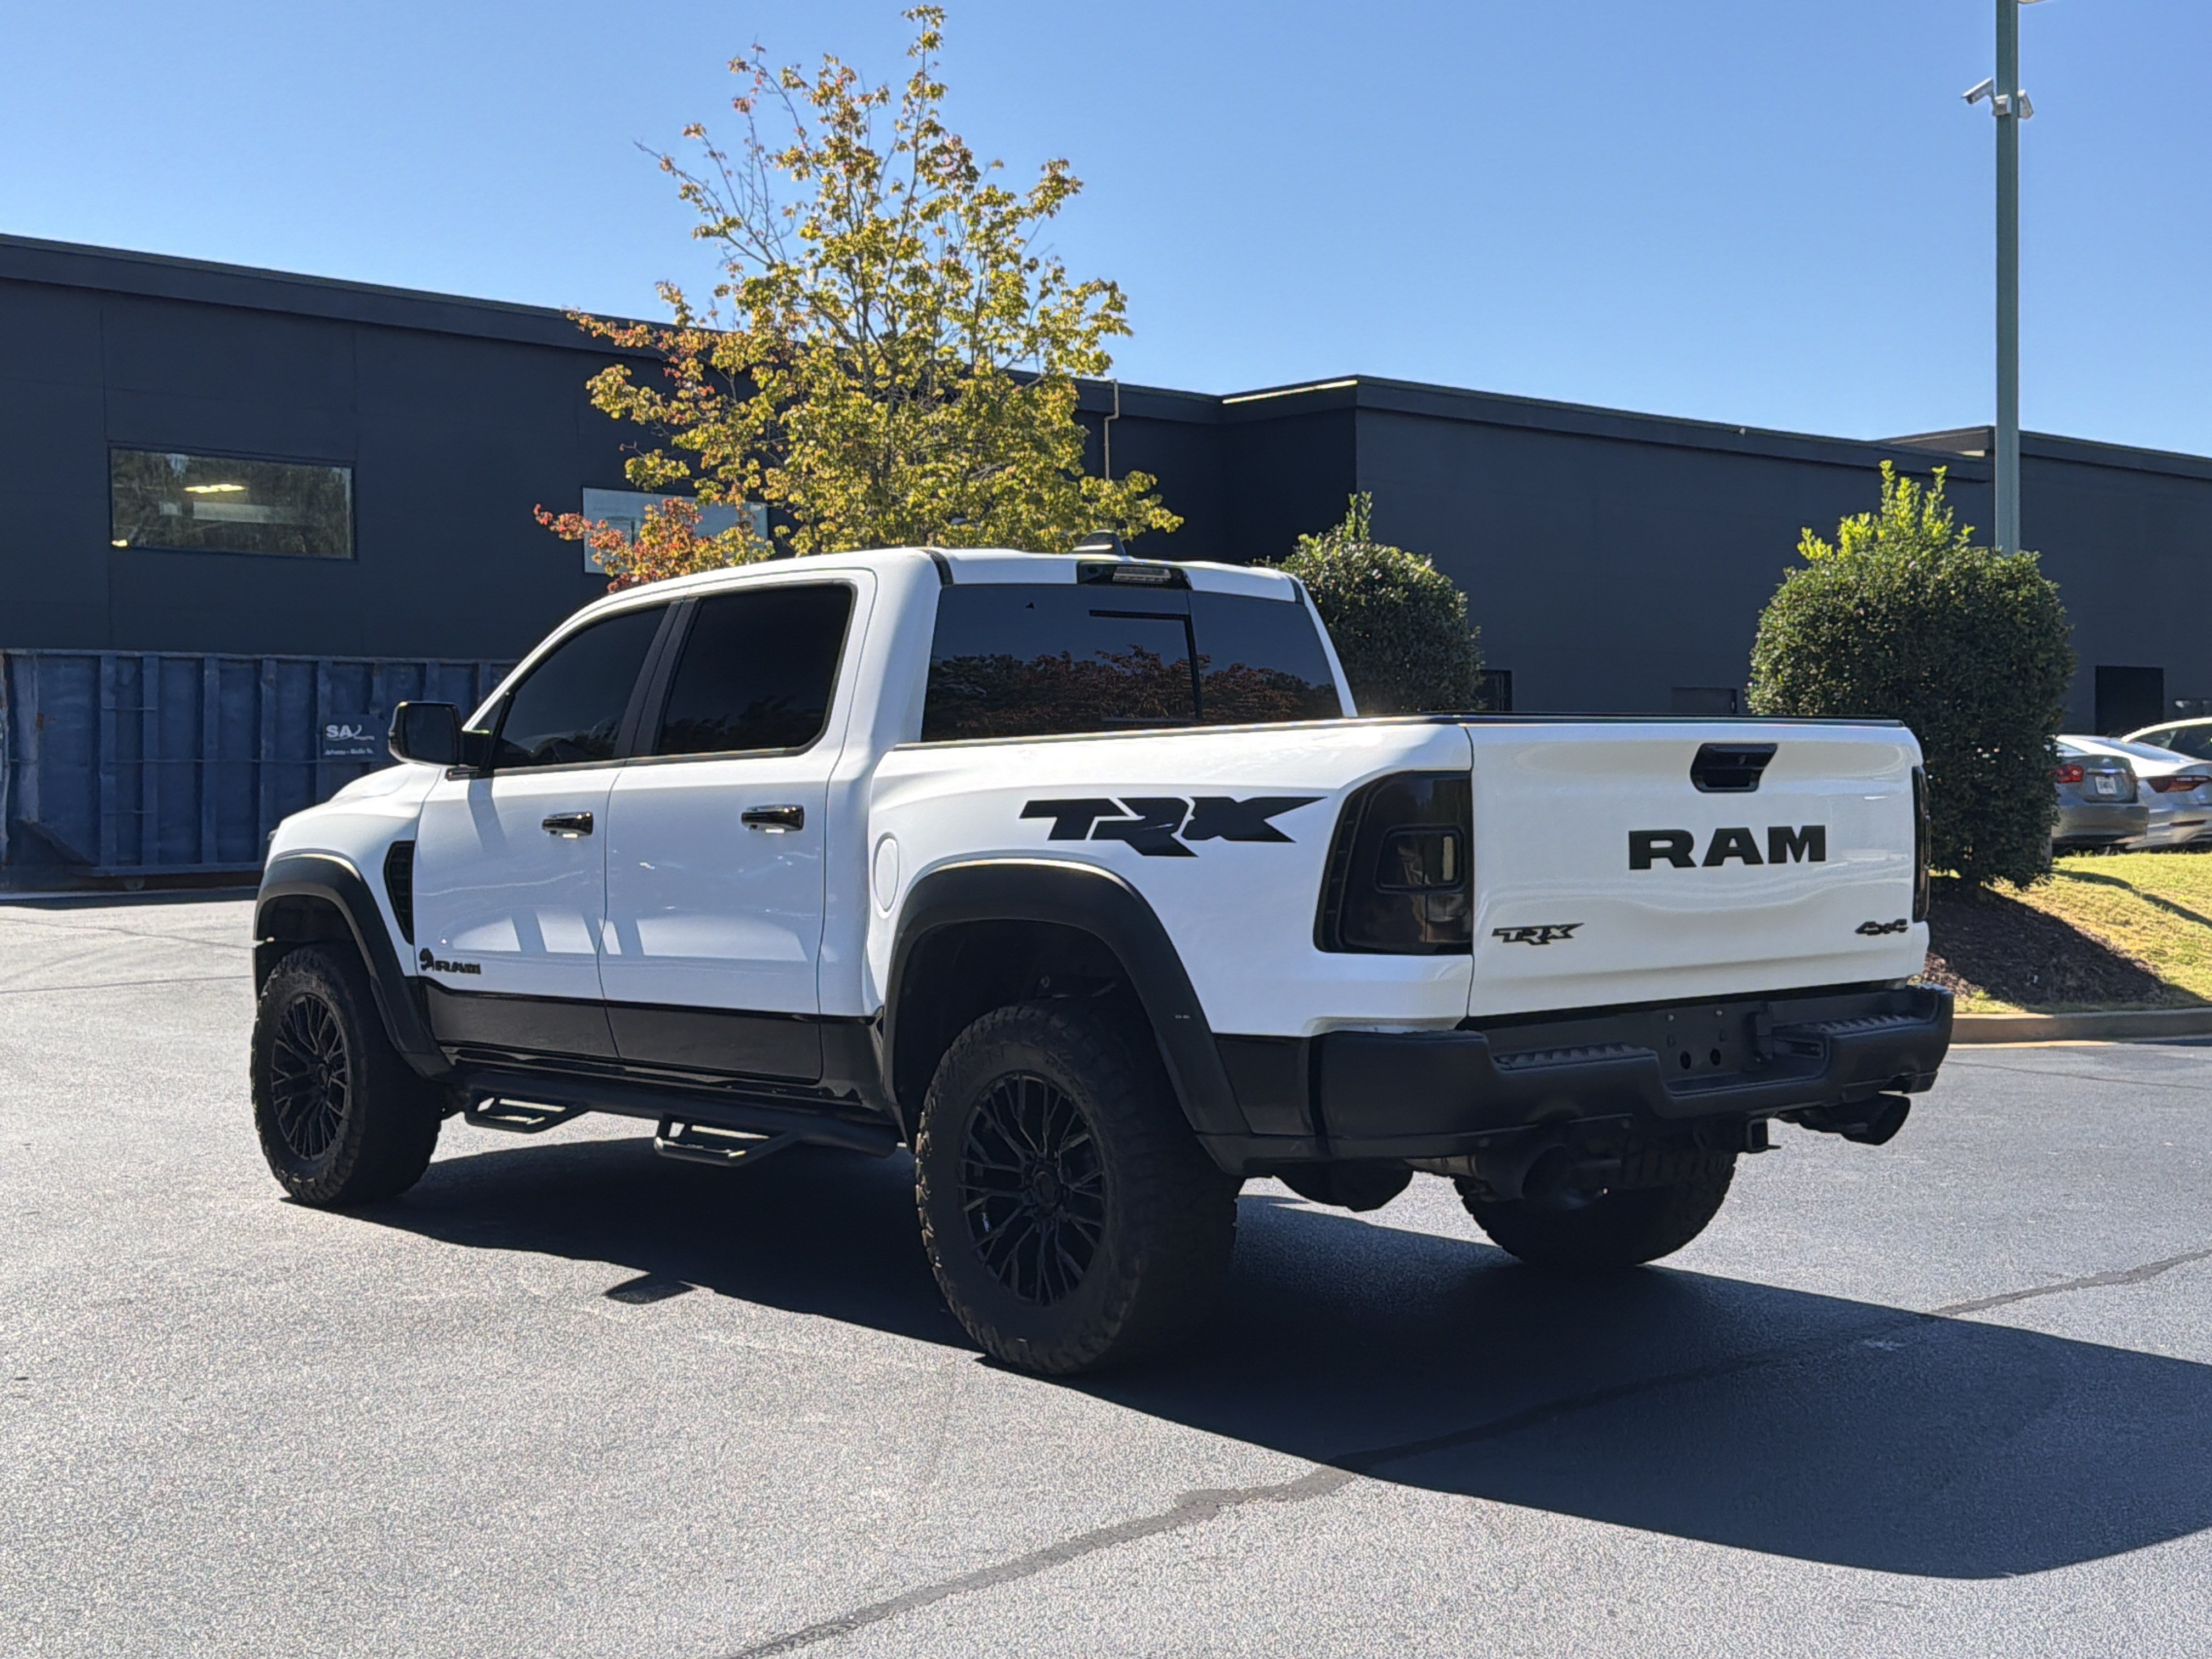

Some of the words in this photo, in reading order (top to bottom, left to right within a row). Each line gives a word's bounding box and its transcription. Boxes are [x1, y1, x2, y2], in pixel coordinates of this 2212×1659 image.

[1019, 796, 1328, 858] TRX
[1628, 825, 1826, 870] RAM
[1492, 922, 1585, 945] TRX
[435, 960, 481, 975] RAM
